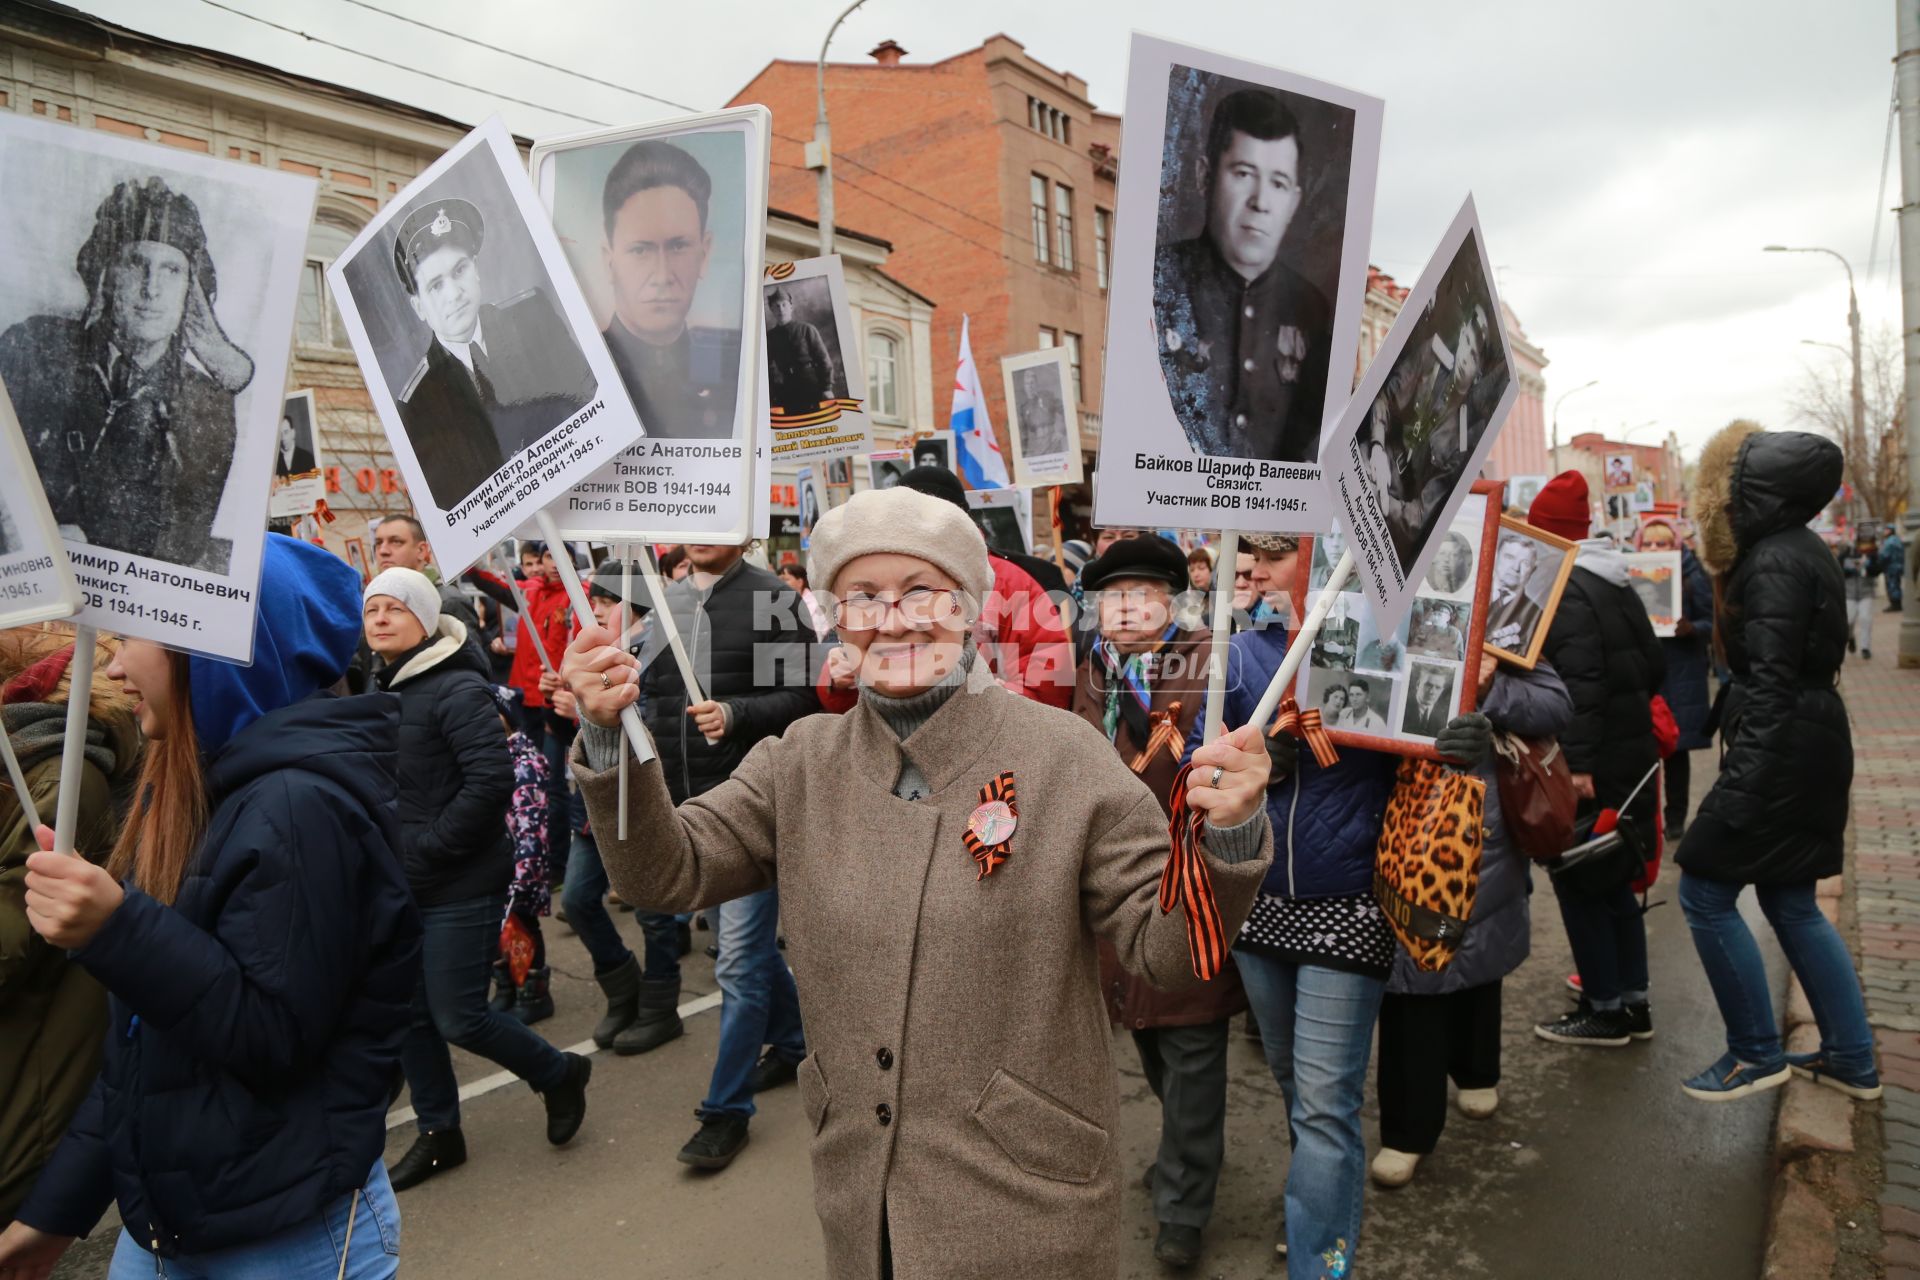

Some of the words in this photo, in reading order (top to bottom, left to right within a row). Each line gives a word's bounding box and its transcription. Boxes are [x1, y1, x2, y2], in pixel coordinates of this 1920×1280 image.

[800, 432, 865, 450] Михайлович
[446, 484, 493, 527] Втулкин
[493, 458, 524, 487] Пётр
[527, 400, 605, 462] Алексеевич
[484, 438, 578, 511] Моряк-подводник.
[515, 479, 540, 501] ВОВ
[541, 441, 594, 483] 1941-1945
[596, 434, 604, 445] г.
[613, 462, 675, 477] Танкист.
[1134, 453, 1194, 473] Байков
[1196, 457, 1256, 480] Шариф
[1259, 462, 1322, 481] Валеевич
[572, 481, 620, 494] астник
[624, 480, 658, 494] ВОВ
[663, 482, 731, 496] 1941-1944
[1206, 475, 1263, 492] Связист.
[569, 498, 611, 511] Погиб
[615, 502, 624, 511] в
[628, 499, 716, 517] Белоруссии
[1147, 490, 1207, 508] Участник
[1211, 494, 1242, 509] ВОВ
[1245, 495, 1299, 512] 1941-1945
[1300, 500, 1308, 512] г.
[1349, 437, 1368, 495] Петунин
[1365, 490, 1384, 532] Юрий
[1380, 527, 1405, 593] Матвеевич
[1337, 471, 1357, 527] Участник
[1354, 522, 1368, 551] ВОВ
[1365, 549, 1386, 600] 1941-1945
[1382, 597, 1389, 608] г.
[1354, 495, 1385, 568] Артиллерист.
[0, 556, 54, 579] иновна
[67, 550, 119, 575] имир
[124, 562, 250, 602] Анатольевич
[33, 583, 42, 594] г.
[109, 597, 189, 627] 1941-1945
[192, 619, 203, 631] г.
